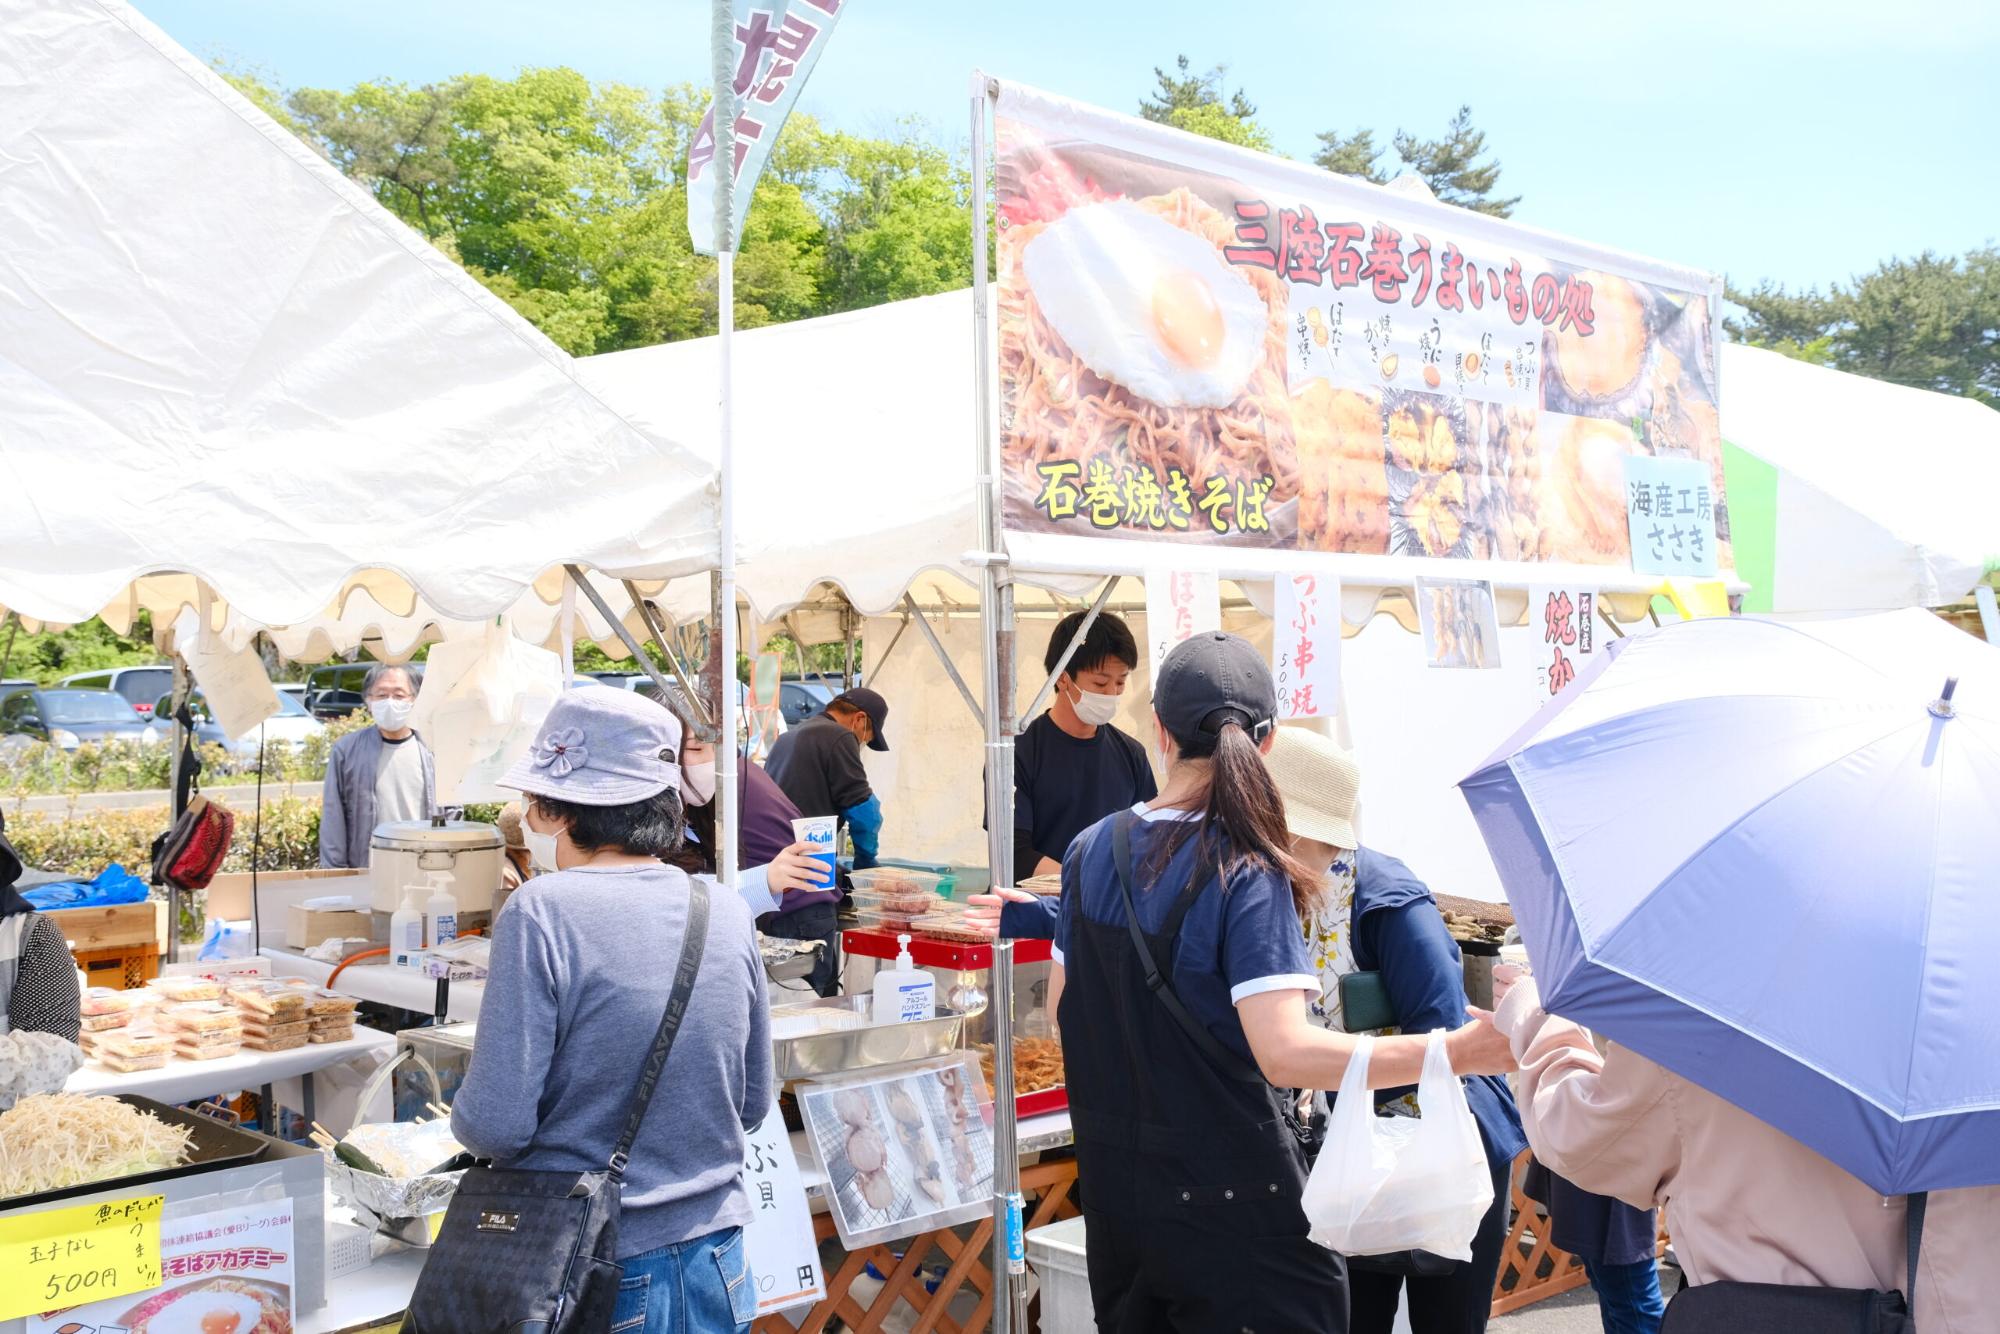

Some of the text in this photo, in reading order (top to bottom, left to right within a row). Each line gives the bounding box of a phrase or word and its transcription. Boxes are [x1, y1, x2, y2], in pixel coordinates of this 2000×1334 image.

[1224, 200, 1596, 337] 三陸石巻うまいもの処
[1034, 457, 1276, 535] 石巻焼きそば
[1630, 480, 1711, 521] 海産工房
[1647, 523, 1704, 563] ささき
[1291, 574, 1319, 717] つぶ串焼
[489, 1214, 506, 1224] FILA
[29, 1239, 96, 1265] 玉子なし
[44, 1267, 117, 1300] 500円
